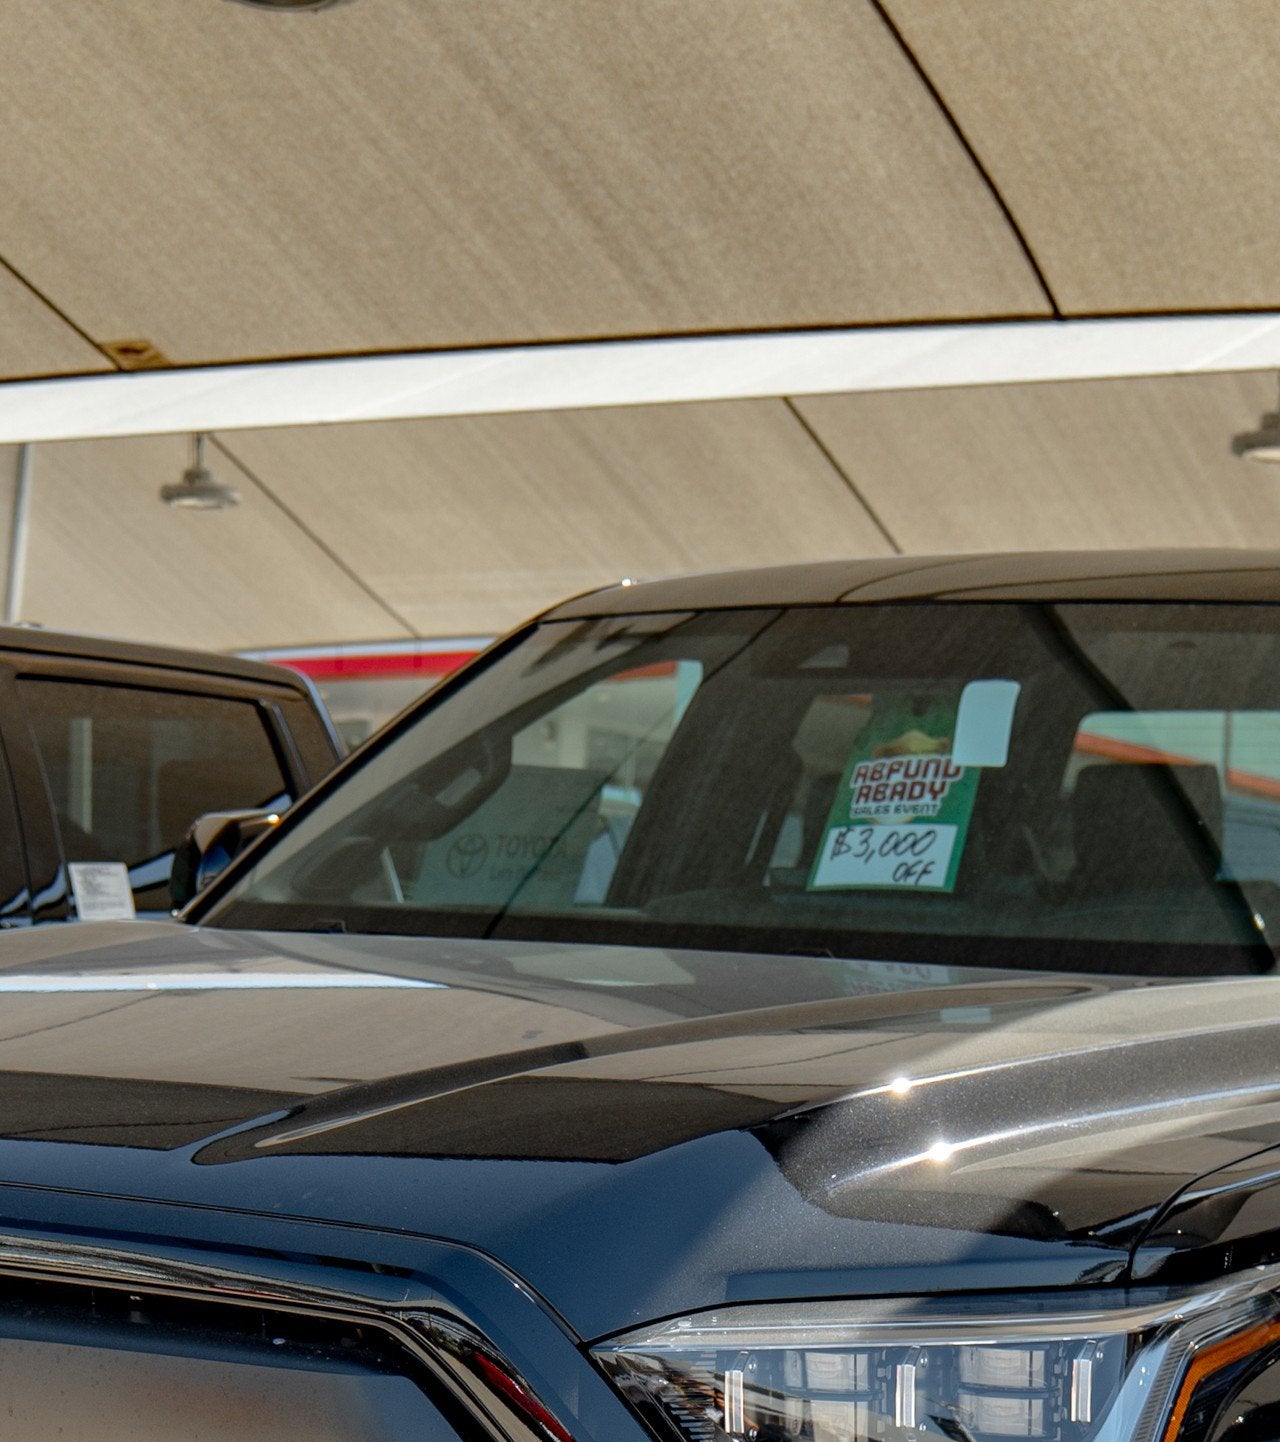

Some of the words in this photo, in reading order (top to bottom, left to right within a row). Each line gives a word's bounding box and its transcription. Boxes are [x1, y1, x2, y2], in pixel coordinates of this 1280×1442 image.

[855, 780, 947, 804] READY
[894, 804, 938, 814] EVENT
[830, 827, 937, 864] $3,000
